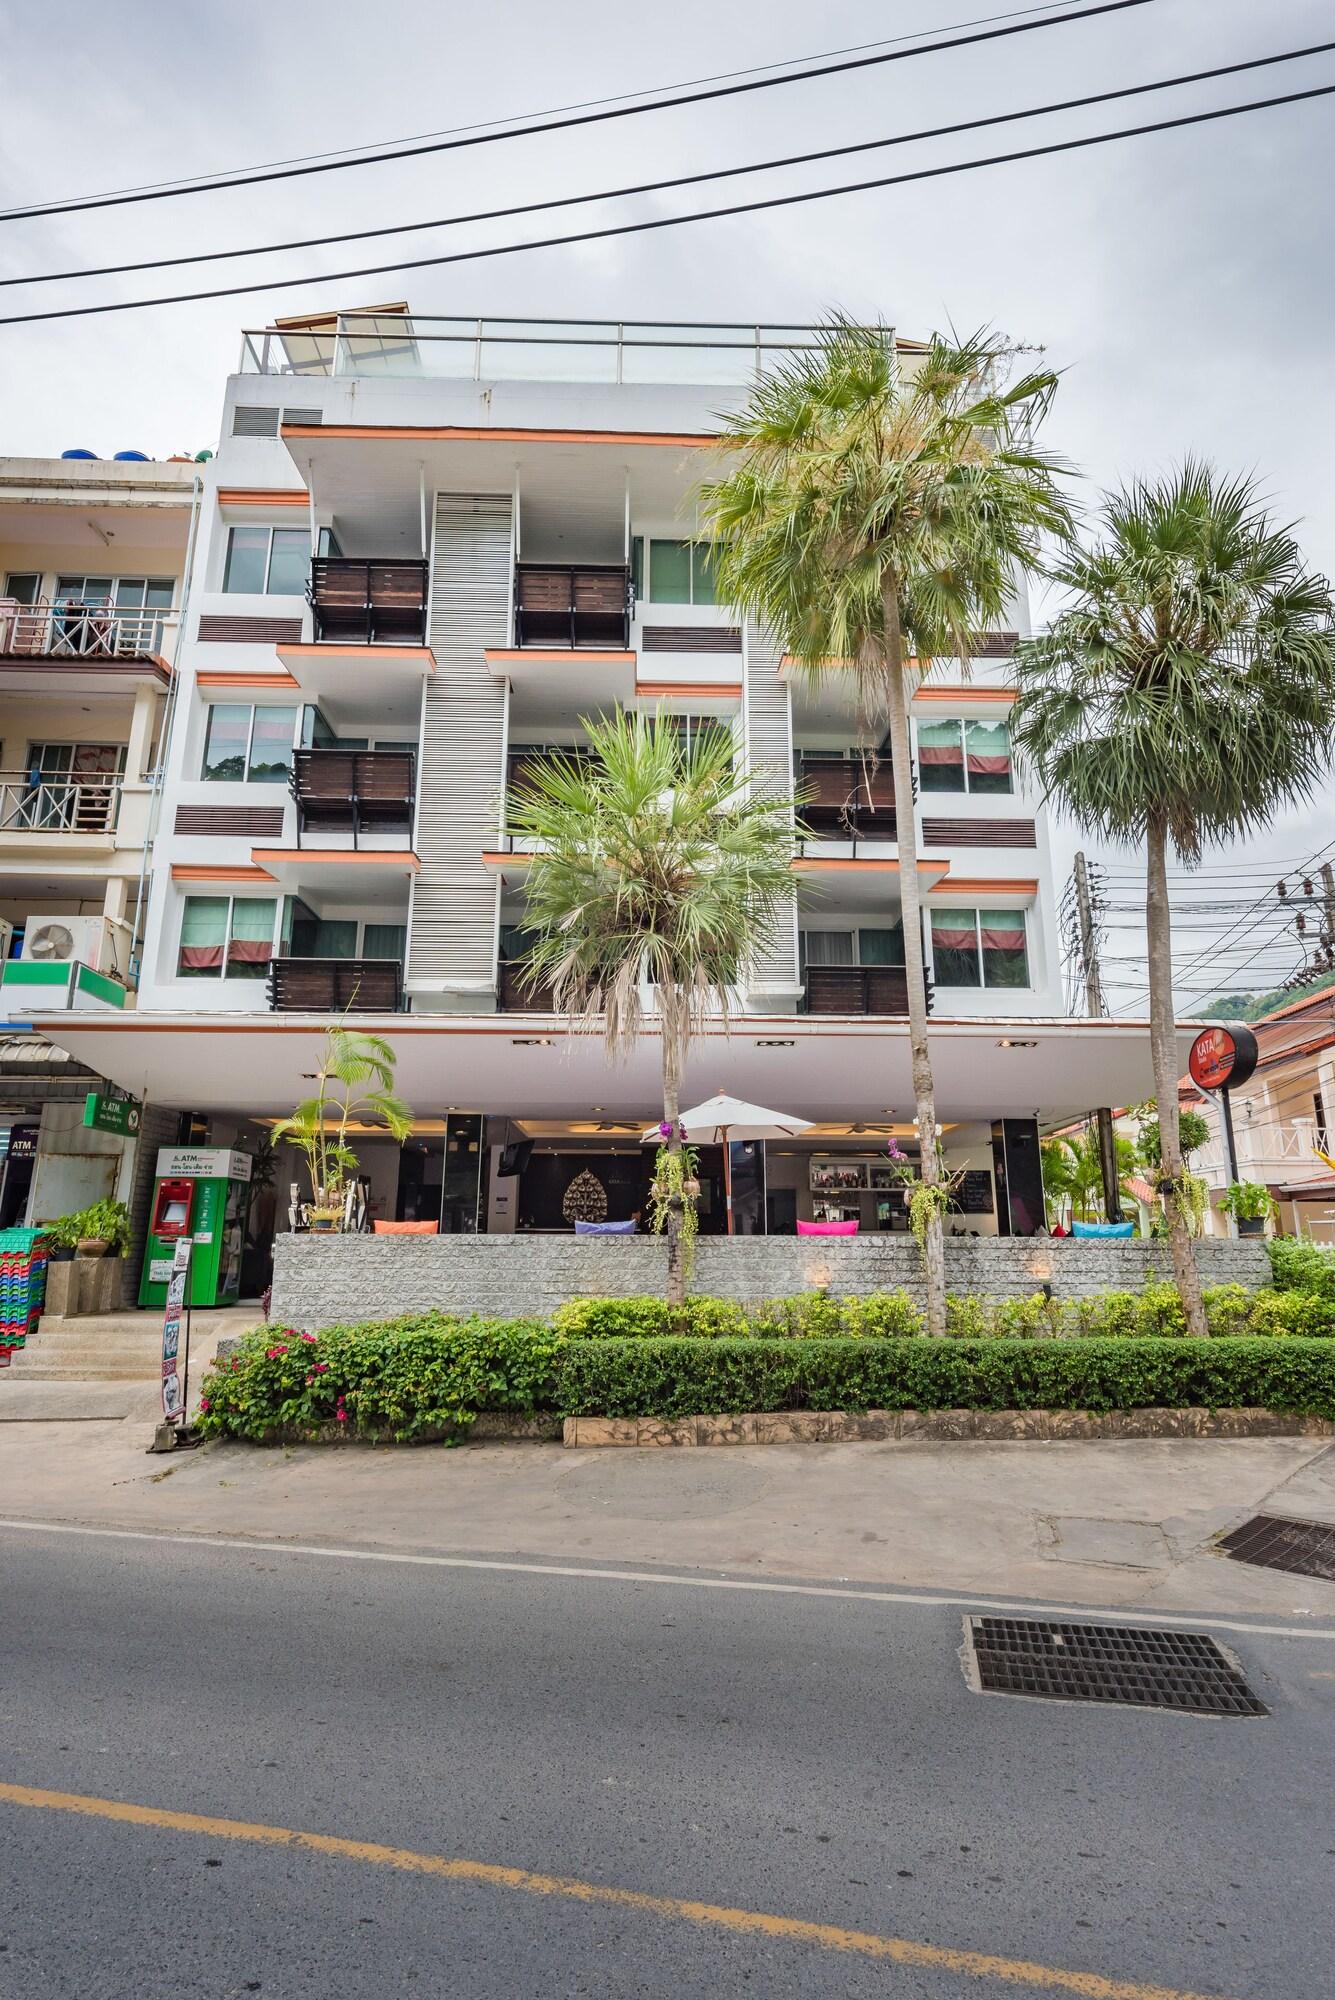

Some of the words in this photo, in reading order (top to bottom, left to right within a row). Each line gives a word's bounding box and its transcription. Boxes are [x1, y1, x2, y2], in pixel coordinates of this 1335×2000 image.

[1196, 1038, 1215, 1058] KATA
[107, 1102, 121, 1113] ATM
[12, 1141, 31, 1150] ATM
[181, 1154, 198, 1162] ATM
